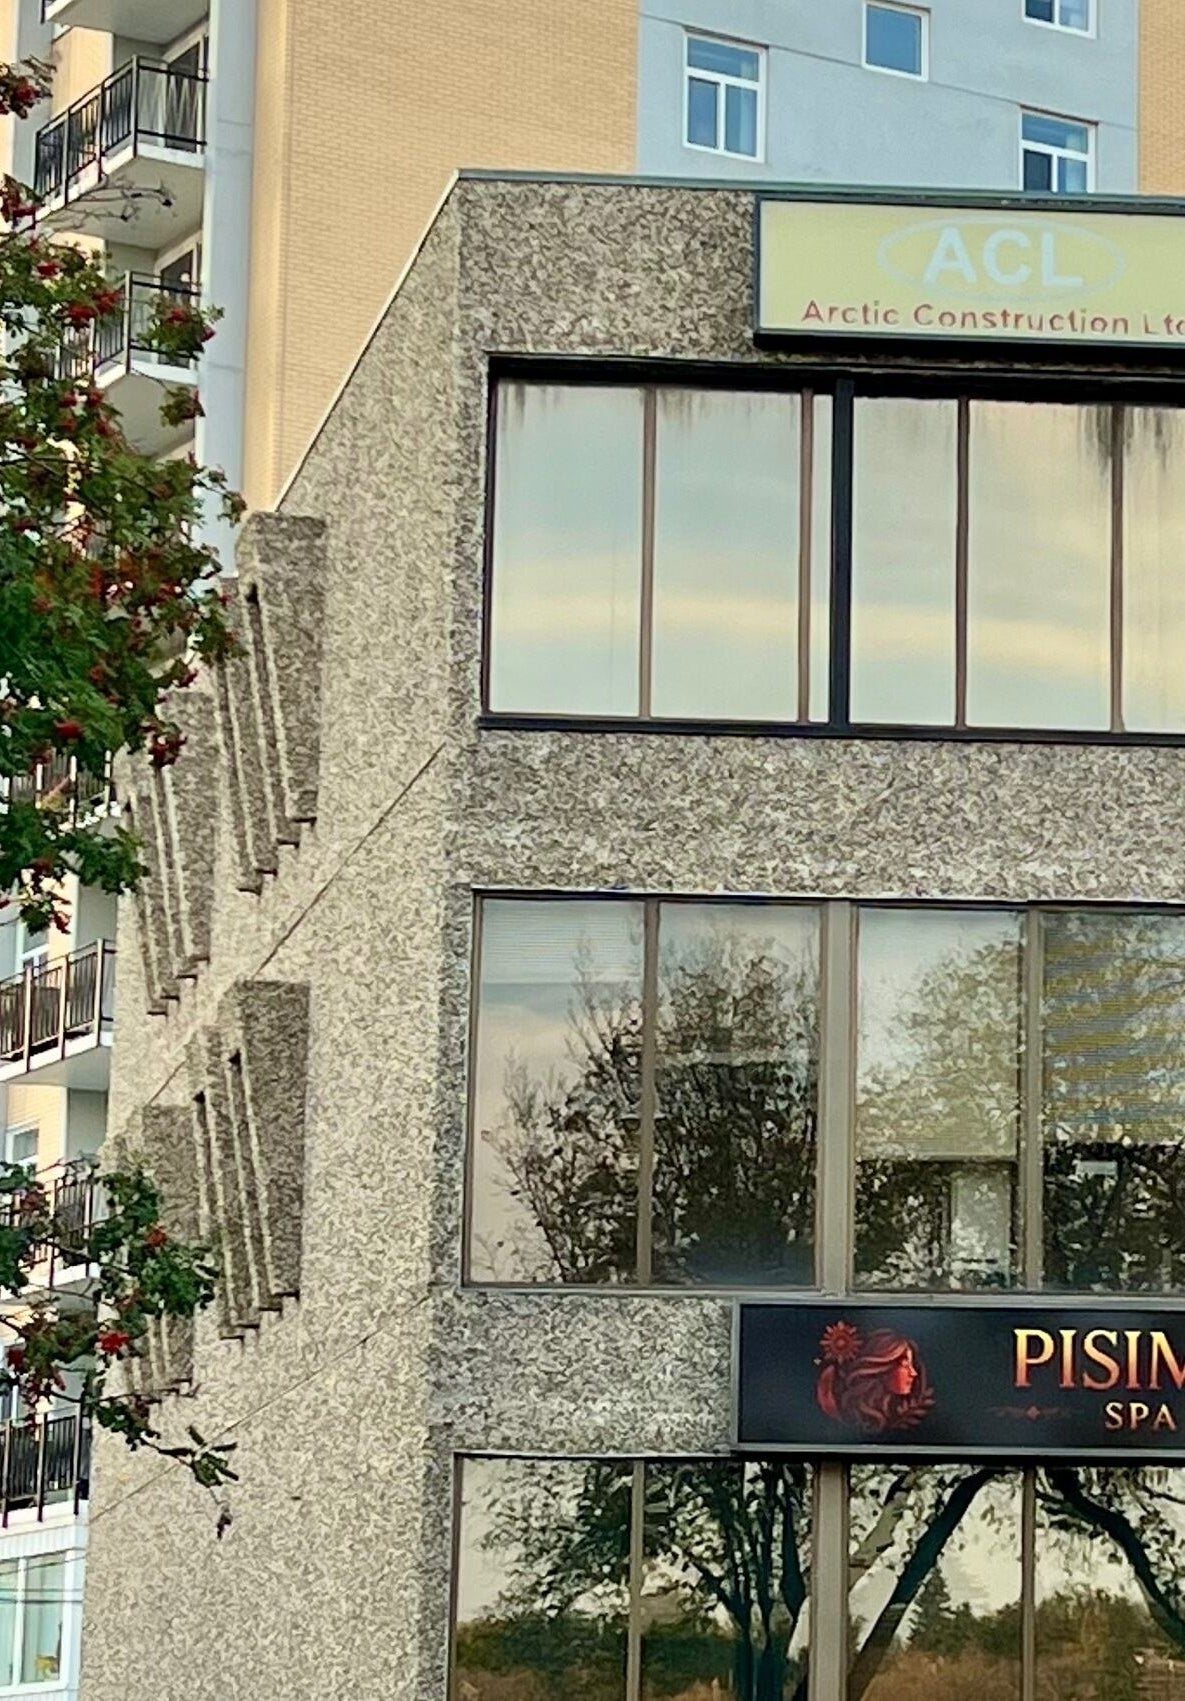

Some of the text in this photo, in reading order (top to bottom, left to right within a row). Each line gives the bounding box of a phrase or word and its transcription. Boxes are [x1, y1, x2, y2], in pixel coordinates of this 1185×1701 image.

[921, 226, 1083, 288] ACL
[802, 300, 900, 327] Arctic
[914, 303, 1130, 335] Construction
[1105, 1402, 1177, 1431] SPA
